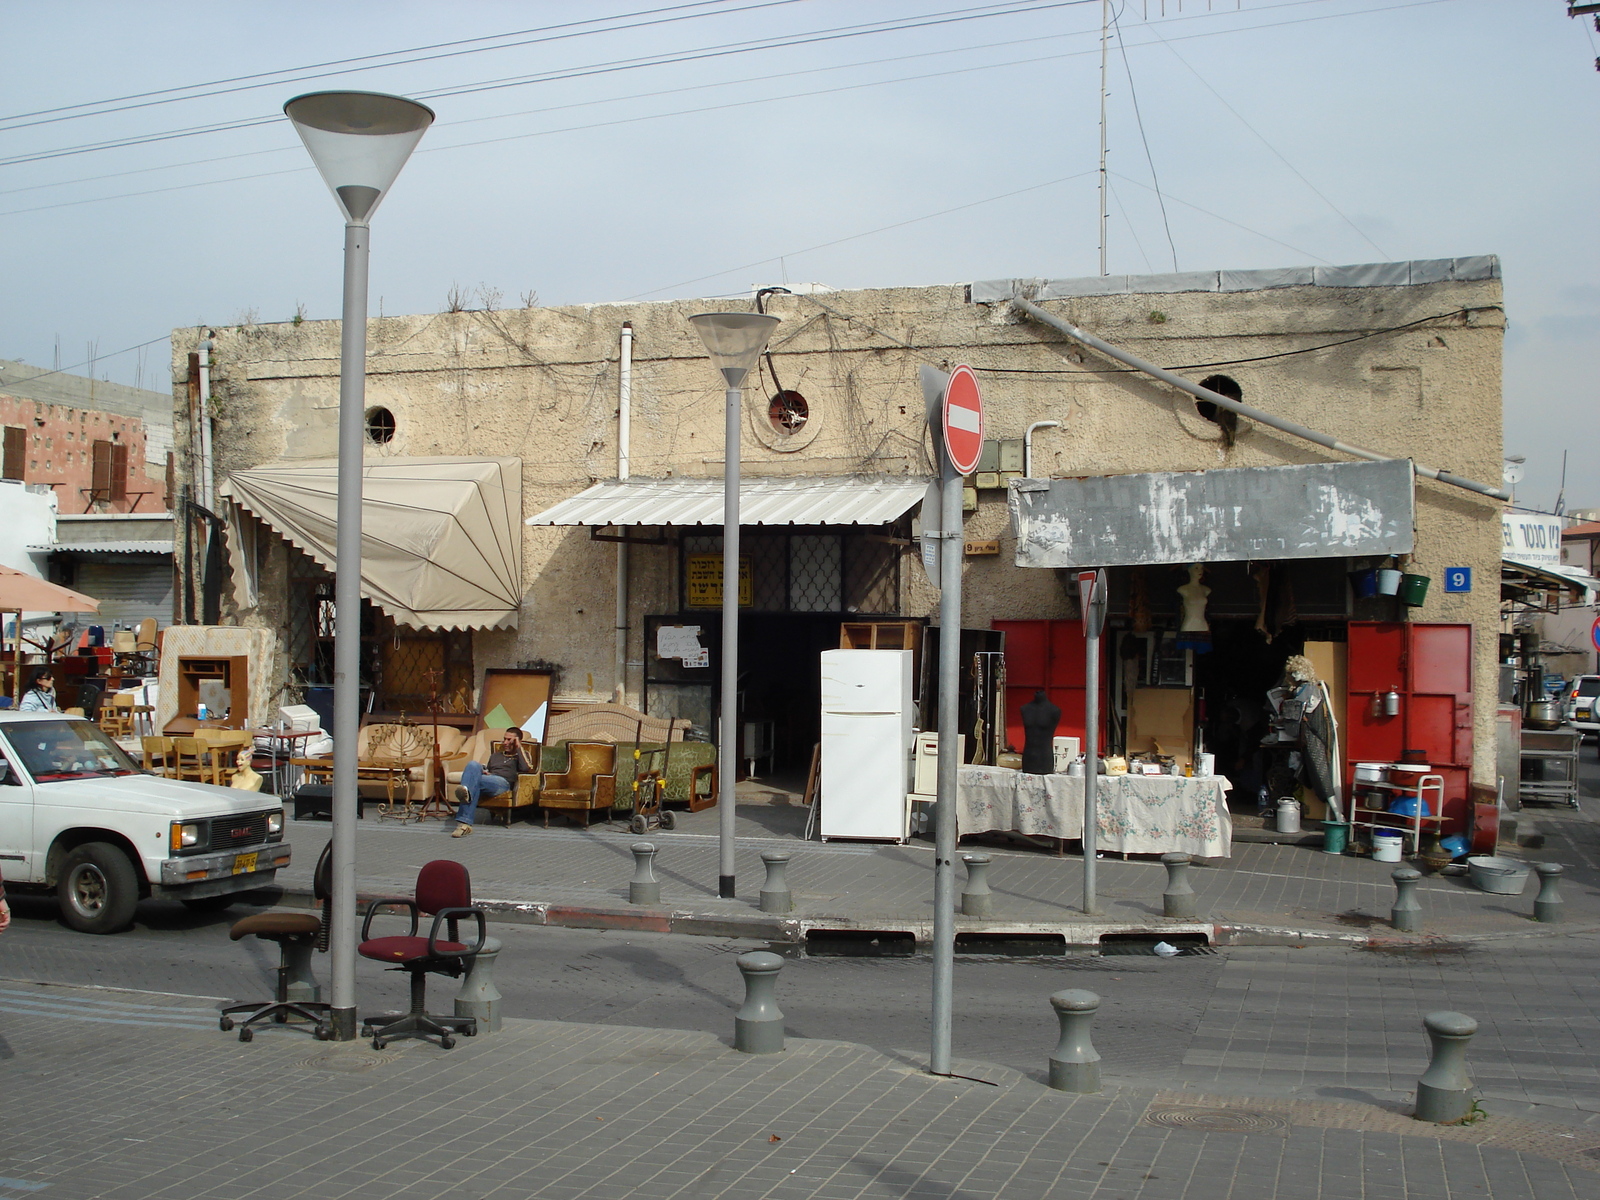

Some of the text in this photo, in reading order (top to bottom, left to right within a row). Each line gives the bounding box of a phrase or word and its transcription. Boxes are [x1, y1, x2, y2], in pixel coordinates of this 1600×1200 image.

[1520, 524, 1546, 549] סנטר
[1453, 573, 1465, 587] 9
[231, 828, 252, 837] GMC
